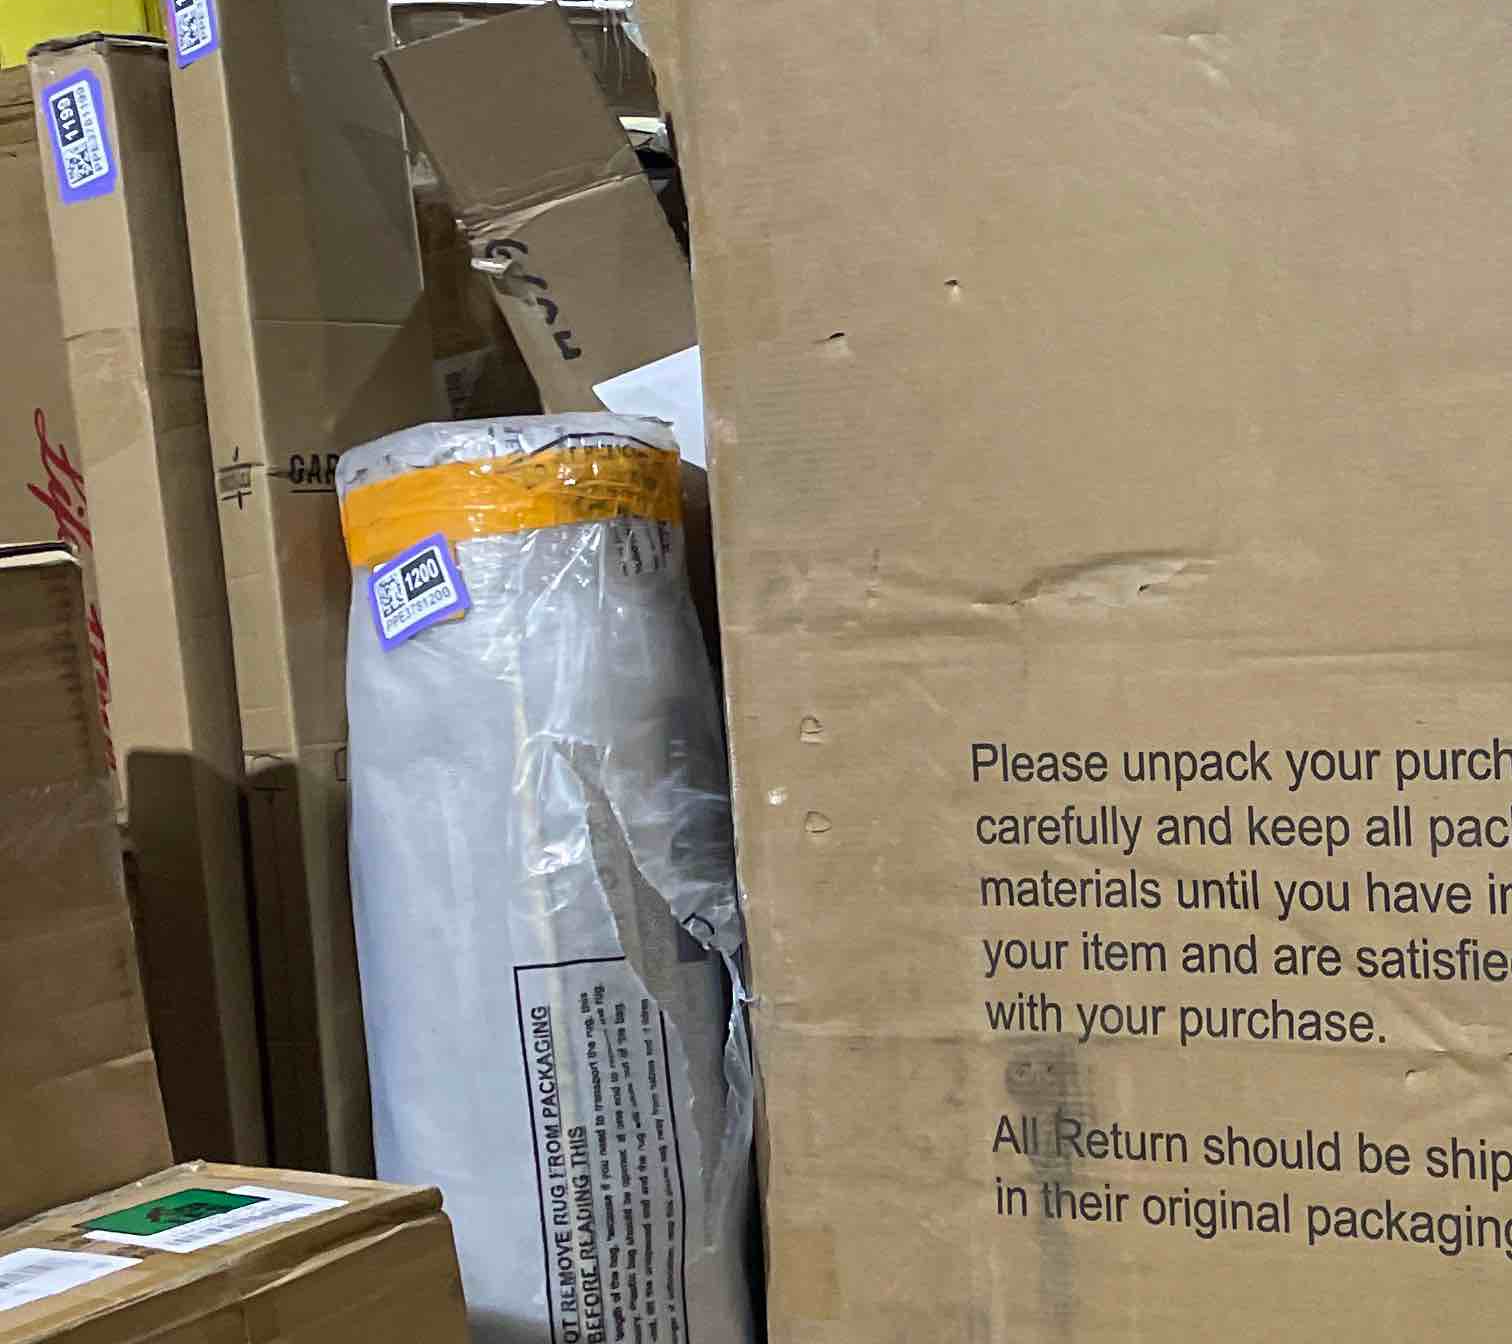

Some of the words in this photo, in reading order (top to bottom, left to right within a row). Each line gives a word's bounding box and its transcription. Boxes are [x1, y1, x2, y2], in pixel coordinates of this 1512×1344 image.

[57, 97, 79, 140] 1199
[404, 557, 439, 592] 1200
[971, 741, 1108, 782] Please
[1123, 740, 1271, 790] unpack
[1287, 745, 1380, 792] your
[976, 808, 1141, 856] carefully
[1157, 806, 1230, 846] and
[1249, 808, 1349, 856] keep
[1366, 807, 1412, 849] all
[980, 870, 1160, 910] materials
[1176, 872, 1259, 913] until
[1274, 880, 1349, 920] you
[1367, 873, 1471, 915] have
[983, 939, 1069, 979] your
[1081, 932, 1167, 973] item
[1182, 936, 1257, 975] and
[1273, 946, 1341, 977] are
[985, 995, 1062, 1032] with
[1076, 1004, 1165, 1042] your
[1179, 1001, 1387, 1048] purchase.
[531, 1006, 558, 1117] PACKAGING
[544, 1125, 564, 1178] FROM
[567, 1126, 588, 1168] THIS
[993, 1117, 1037, 1156] All
[1055, 1118, 1188, 1164] Return
[1204, 1132, 1339, 1173] should
[1358, 1135, 1410, 1176] be
[551, 1185, 568, 1225] RUG
[572, 1175, 594, 1260] READING
[996, 1178, 1027, 1216] in
[1042, 1181, 1129, 1225] their
[1143, 1191, 1290, 1244] original
[554, 1231, 576, 1311] REMOVE
[581, 1266, 604, 1344] BEFORE
